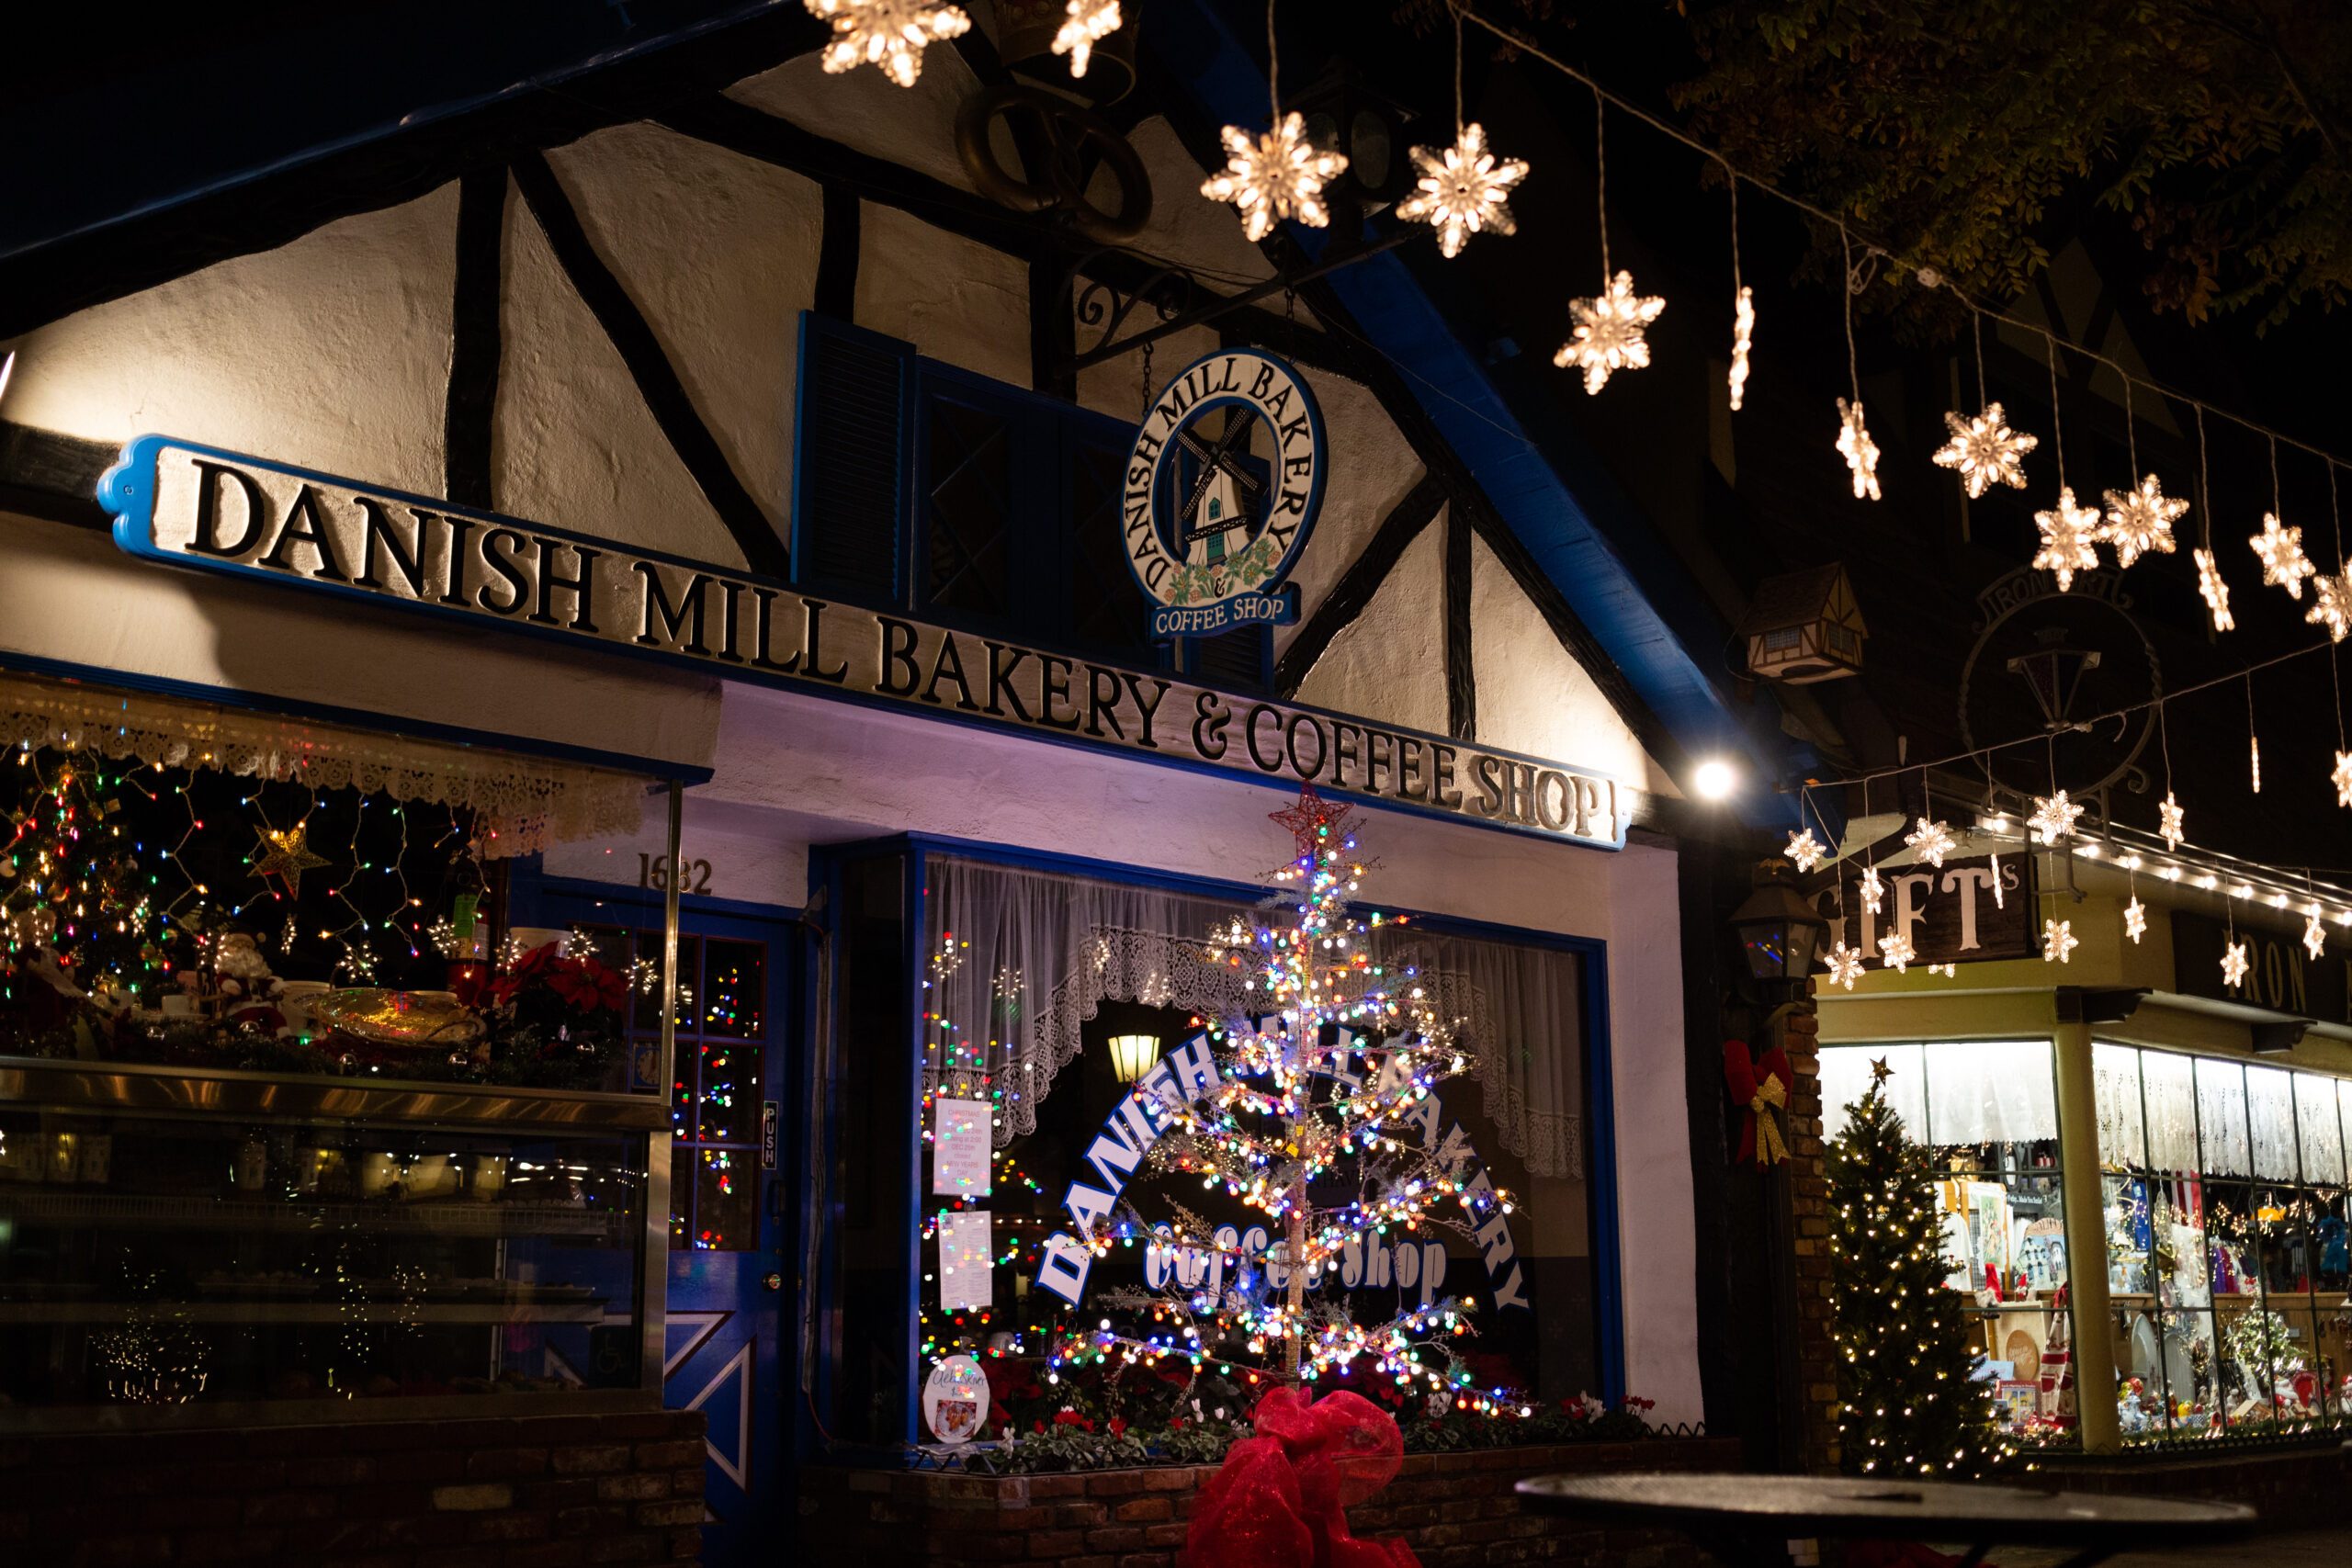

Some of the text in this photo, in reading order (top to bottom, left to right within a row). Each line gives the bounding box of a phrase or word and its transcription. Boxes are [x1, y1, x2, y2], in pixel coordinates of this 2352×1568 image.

[1125, 357, 1312, 592] DANISH MILL BAKERY
[185, 458, 1600, 837] DANISH MILL BAKERY & COFFEE SHOP
[1156, 597, 1284, 634] COFFEE SHOP
[1214, 578, 1225, 598] &
[764, 1108, 775, 1163] PUSH
[1035, 1029, 1223, 1311] DANISH
